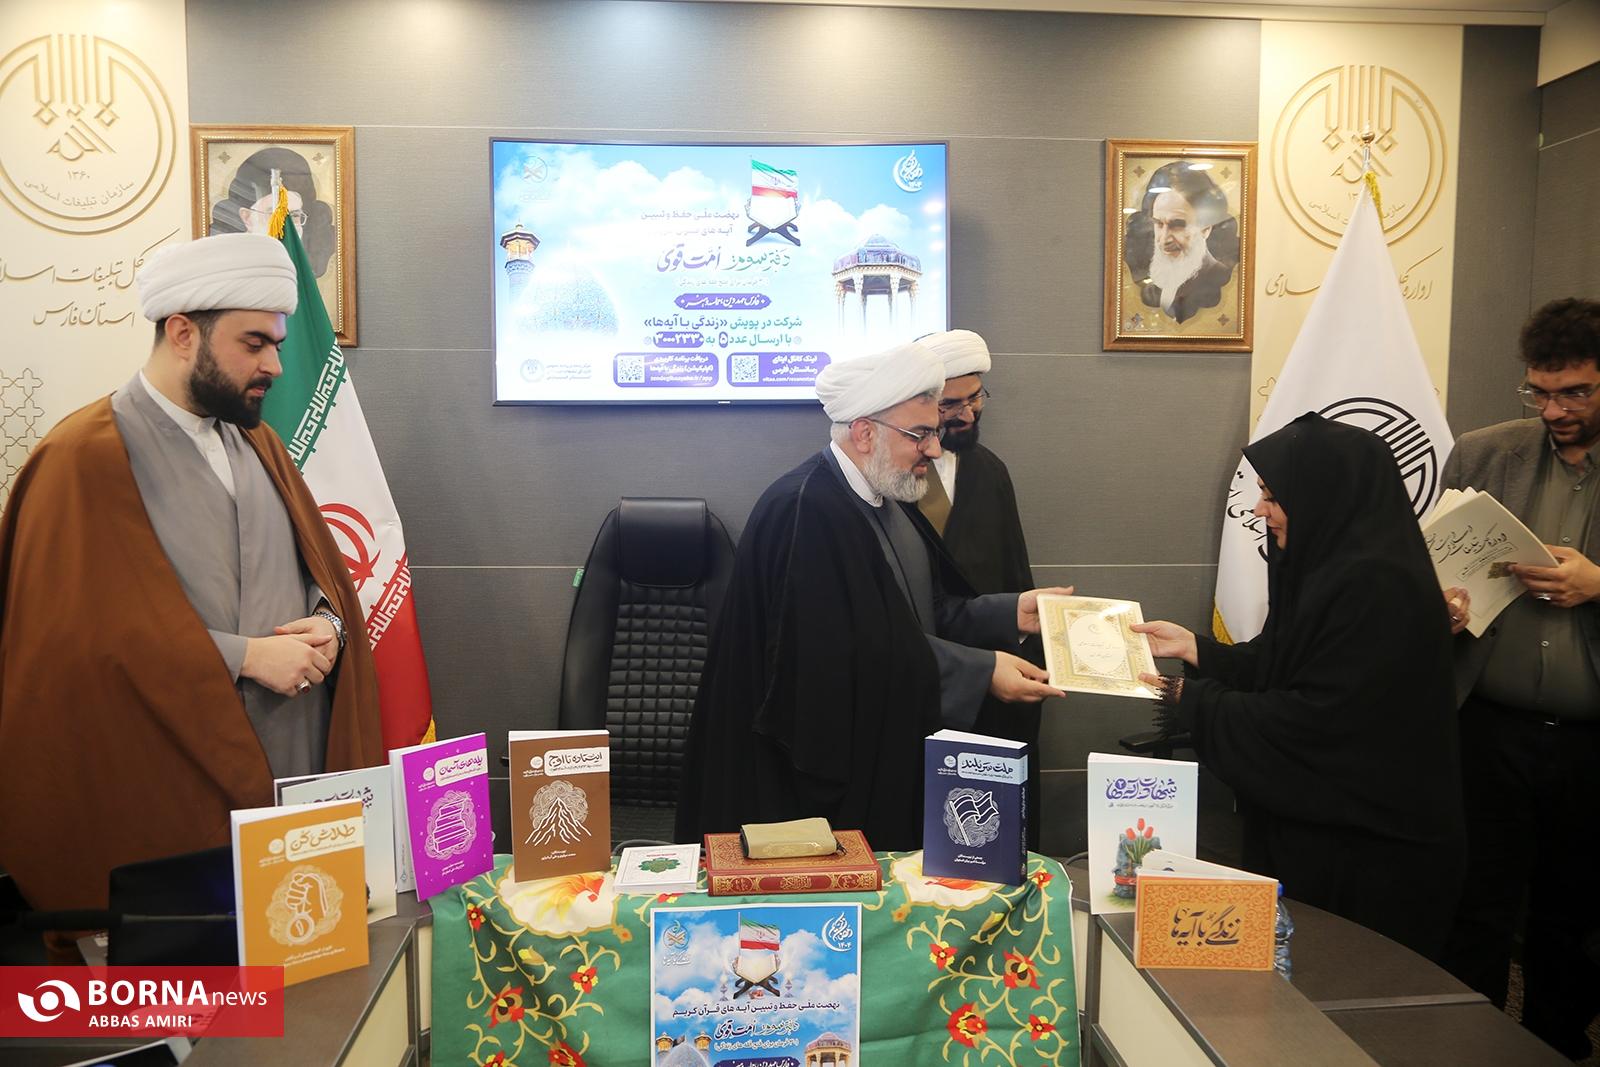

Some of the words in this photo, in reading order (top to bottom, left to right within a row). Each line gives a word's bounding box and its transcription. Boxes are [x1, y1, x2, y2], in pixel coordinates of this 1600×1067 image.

[67, 169, 91, 181] ۱۳۶۰
[23, 180, 61, 202] اسلامی
[100, 180, 135, 206] سازمان
[62, 195, 98, 211] تبلیغات
[671, 210, 692, 218] حفظ
[656, 242, 685, 273] قوی
[55, 259, 123, 291] تبلیغات
[32, 300, 79, 328] فارس
[78, 300, 136, 327] استان
[680, 316, 690, 330] با
[729, 317, 759, 330] پویش
[761, 319, 772, 330] در
[773, 316, 803, 330] شرکت
[705, 335, 715, 345] به
[729, 336, 747, 345] عدد
[749, 333, 783, 347] ارسال
[784, 334, 792, 345] با
[548, 753, 565, 769] اوج
[566, 754, 573, 764] تا
[290, 829, 311, 852] کن
[309, 824, 357, 848] طلاش
[1204, 904, 1242, 946] زندگی
[698, 1003, 720, 1016] قرآن
[720, 1003, 735, 1015] های
[735, 1001, 750, 1012] آیه
[750, 1003, 773, 1014] تبیین
[773, 1003, 778, 1012] و
[779, 1001, 797, 1010] حفظ
[798, 999, 815, 1011] ملی
[815, 1001, 840, 1010] نهضت
[672, 1006, 697, 1018] کریم
[714, 1019, 733, 1040] قوی
